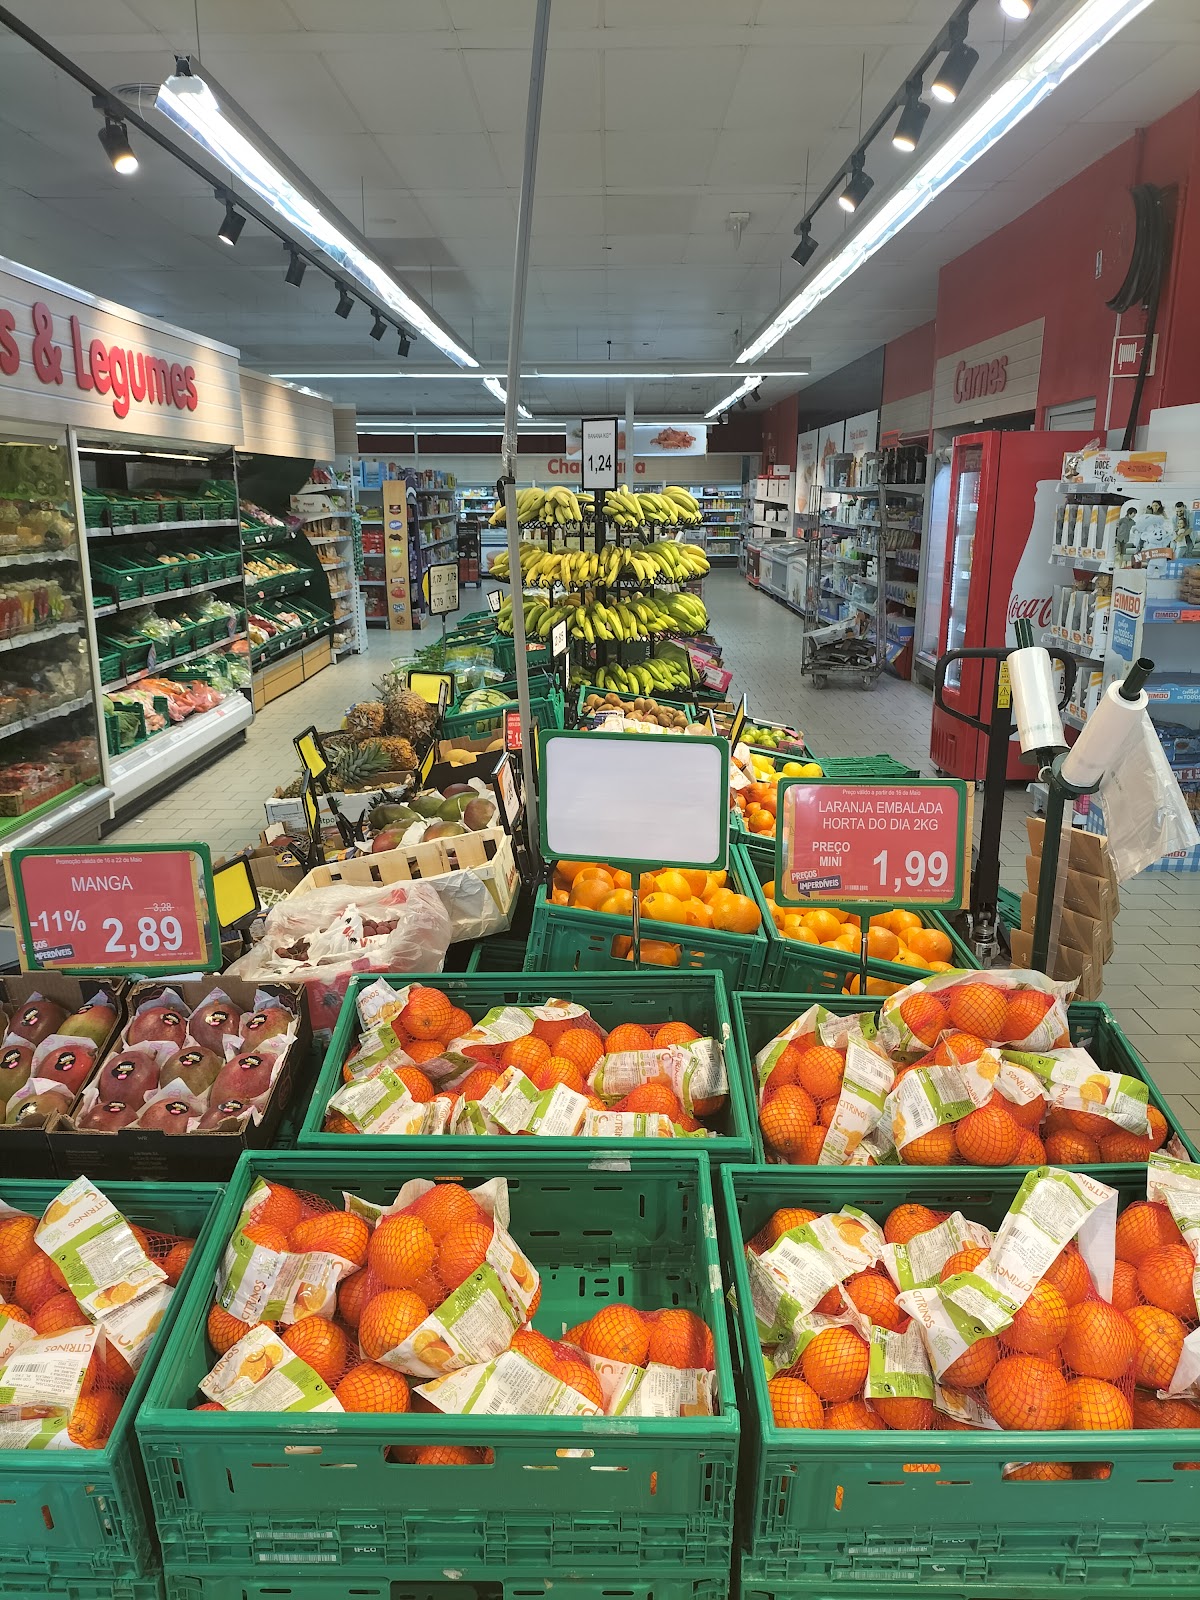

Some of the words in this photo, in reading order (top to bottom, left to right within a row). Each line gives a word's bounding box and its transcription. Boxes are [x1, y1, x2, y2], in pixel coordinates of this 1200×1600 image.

[32, 302, 63, 385] &
[70, 315, 198, 418] Legumes
[953, 355, 1008, 404] Carnes
[588, 454, 612, 474] 1,24
[1114, 592, 1141, 614] BIMBO
[818, 801, 873, 813] LARANJA
[877, 802, 944, 814] EMBALADA
[823, 818, 865, 830] HORTA
[868, 818, 886, 830] DO
[890, 818, 910, 830] DIA
[914, 819, 938, 830] 2KG
[812, 842, 850, 854] PREÇO
[819, 856, 842, 866] MINI
[792, 870, 818, 881] PREÇOS
[873, 850, 948, 893] 1,99
[71, 876, 133, 892] MANGA
[800, 878, 839, 890] IMPERDÍVEIS
[153, 902, 172, 912] 3,28
[30, 910, 87, 932] -11%
[102, 916, 183, 959] 2,89
